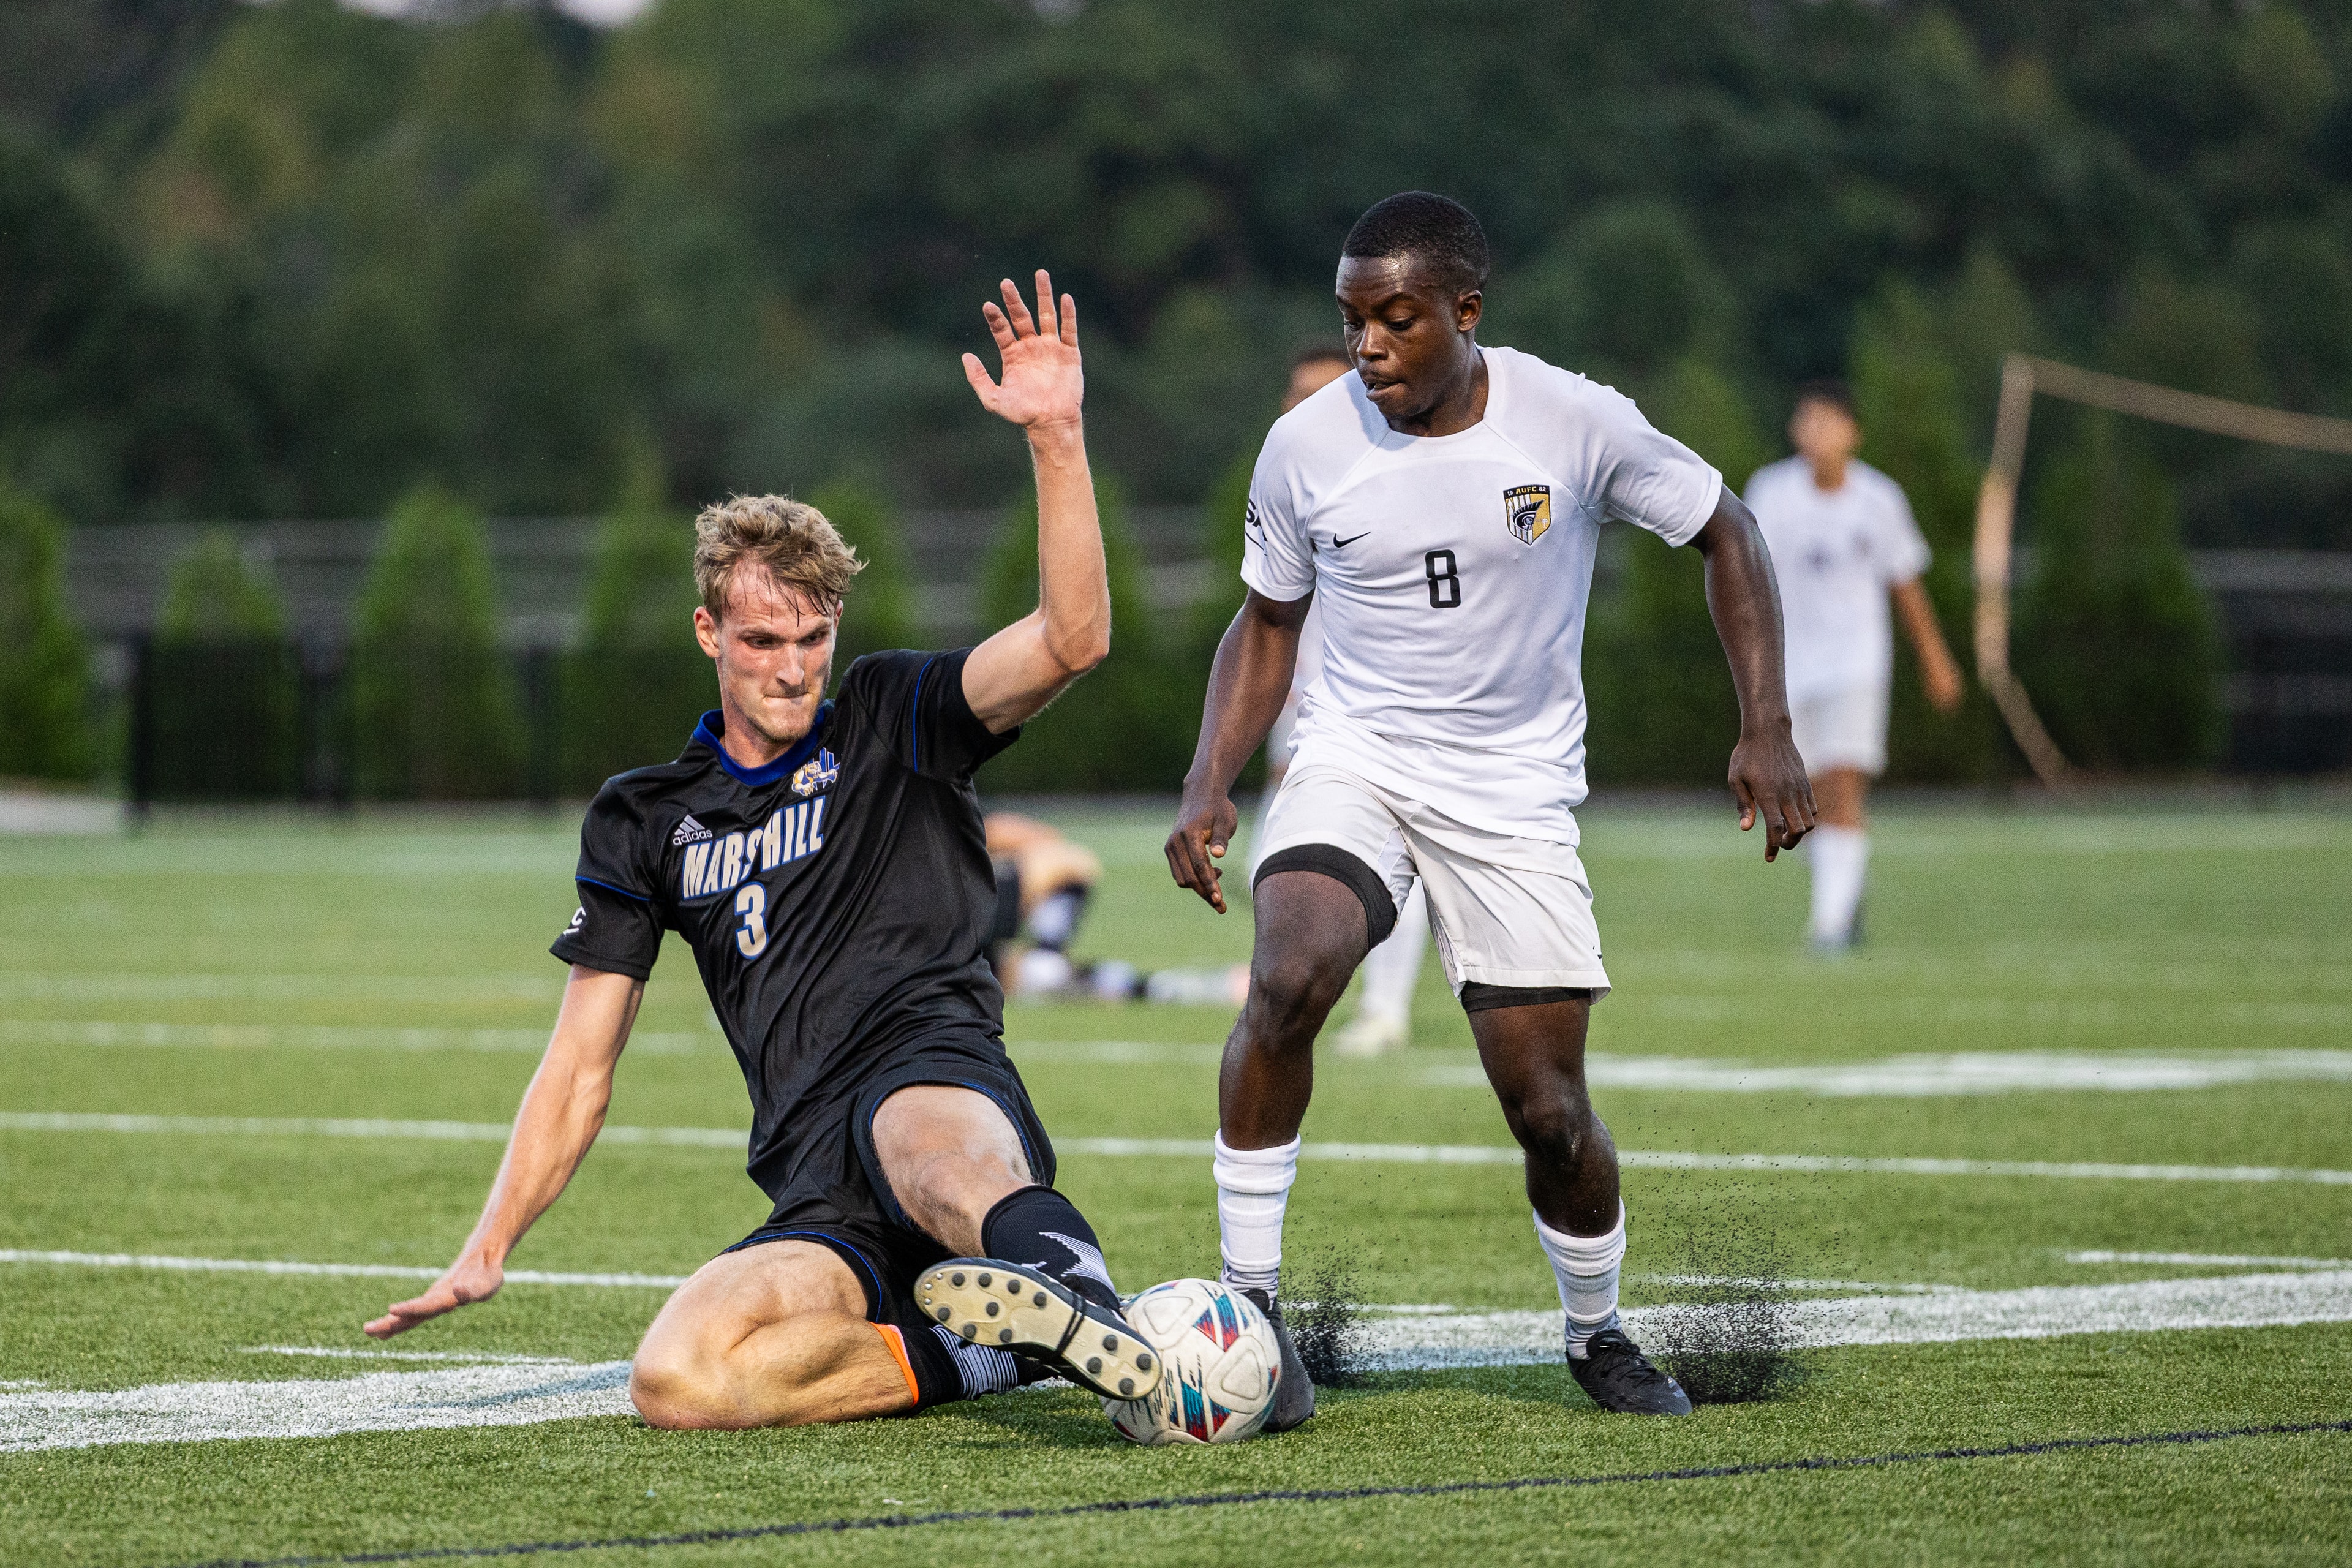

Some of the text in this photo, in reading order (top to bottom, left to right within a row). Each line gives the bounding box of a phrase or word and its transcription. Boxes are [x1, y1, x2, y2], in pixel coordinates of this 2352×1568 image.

[1425, 549, 1461, 608] 8
[673, 828, 713, 846] adidas
[734, 881, 769, 960] 3
